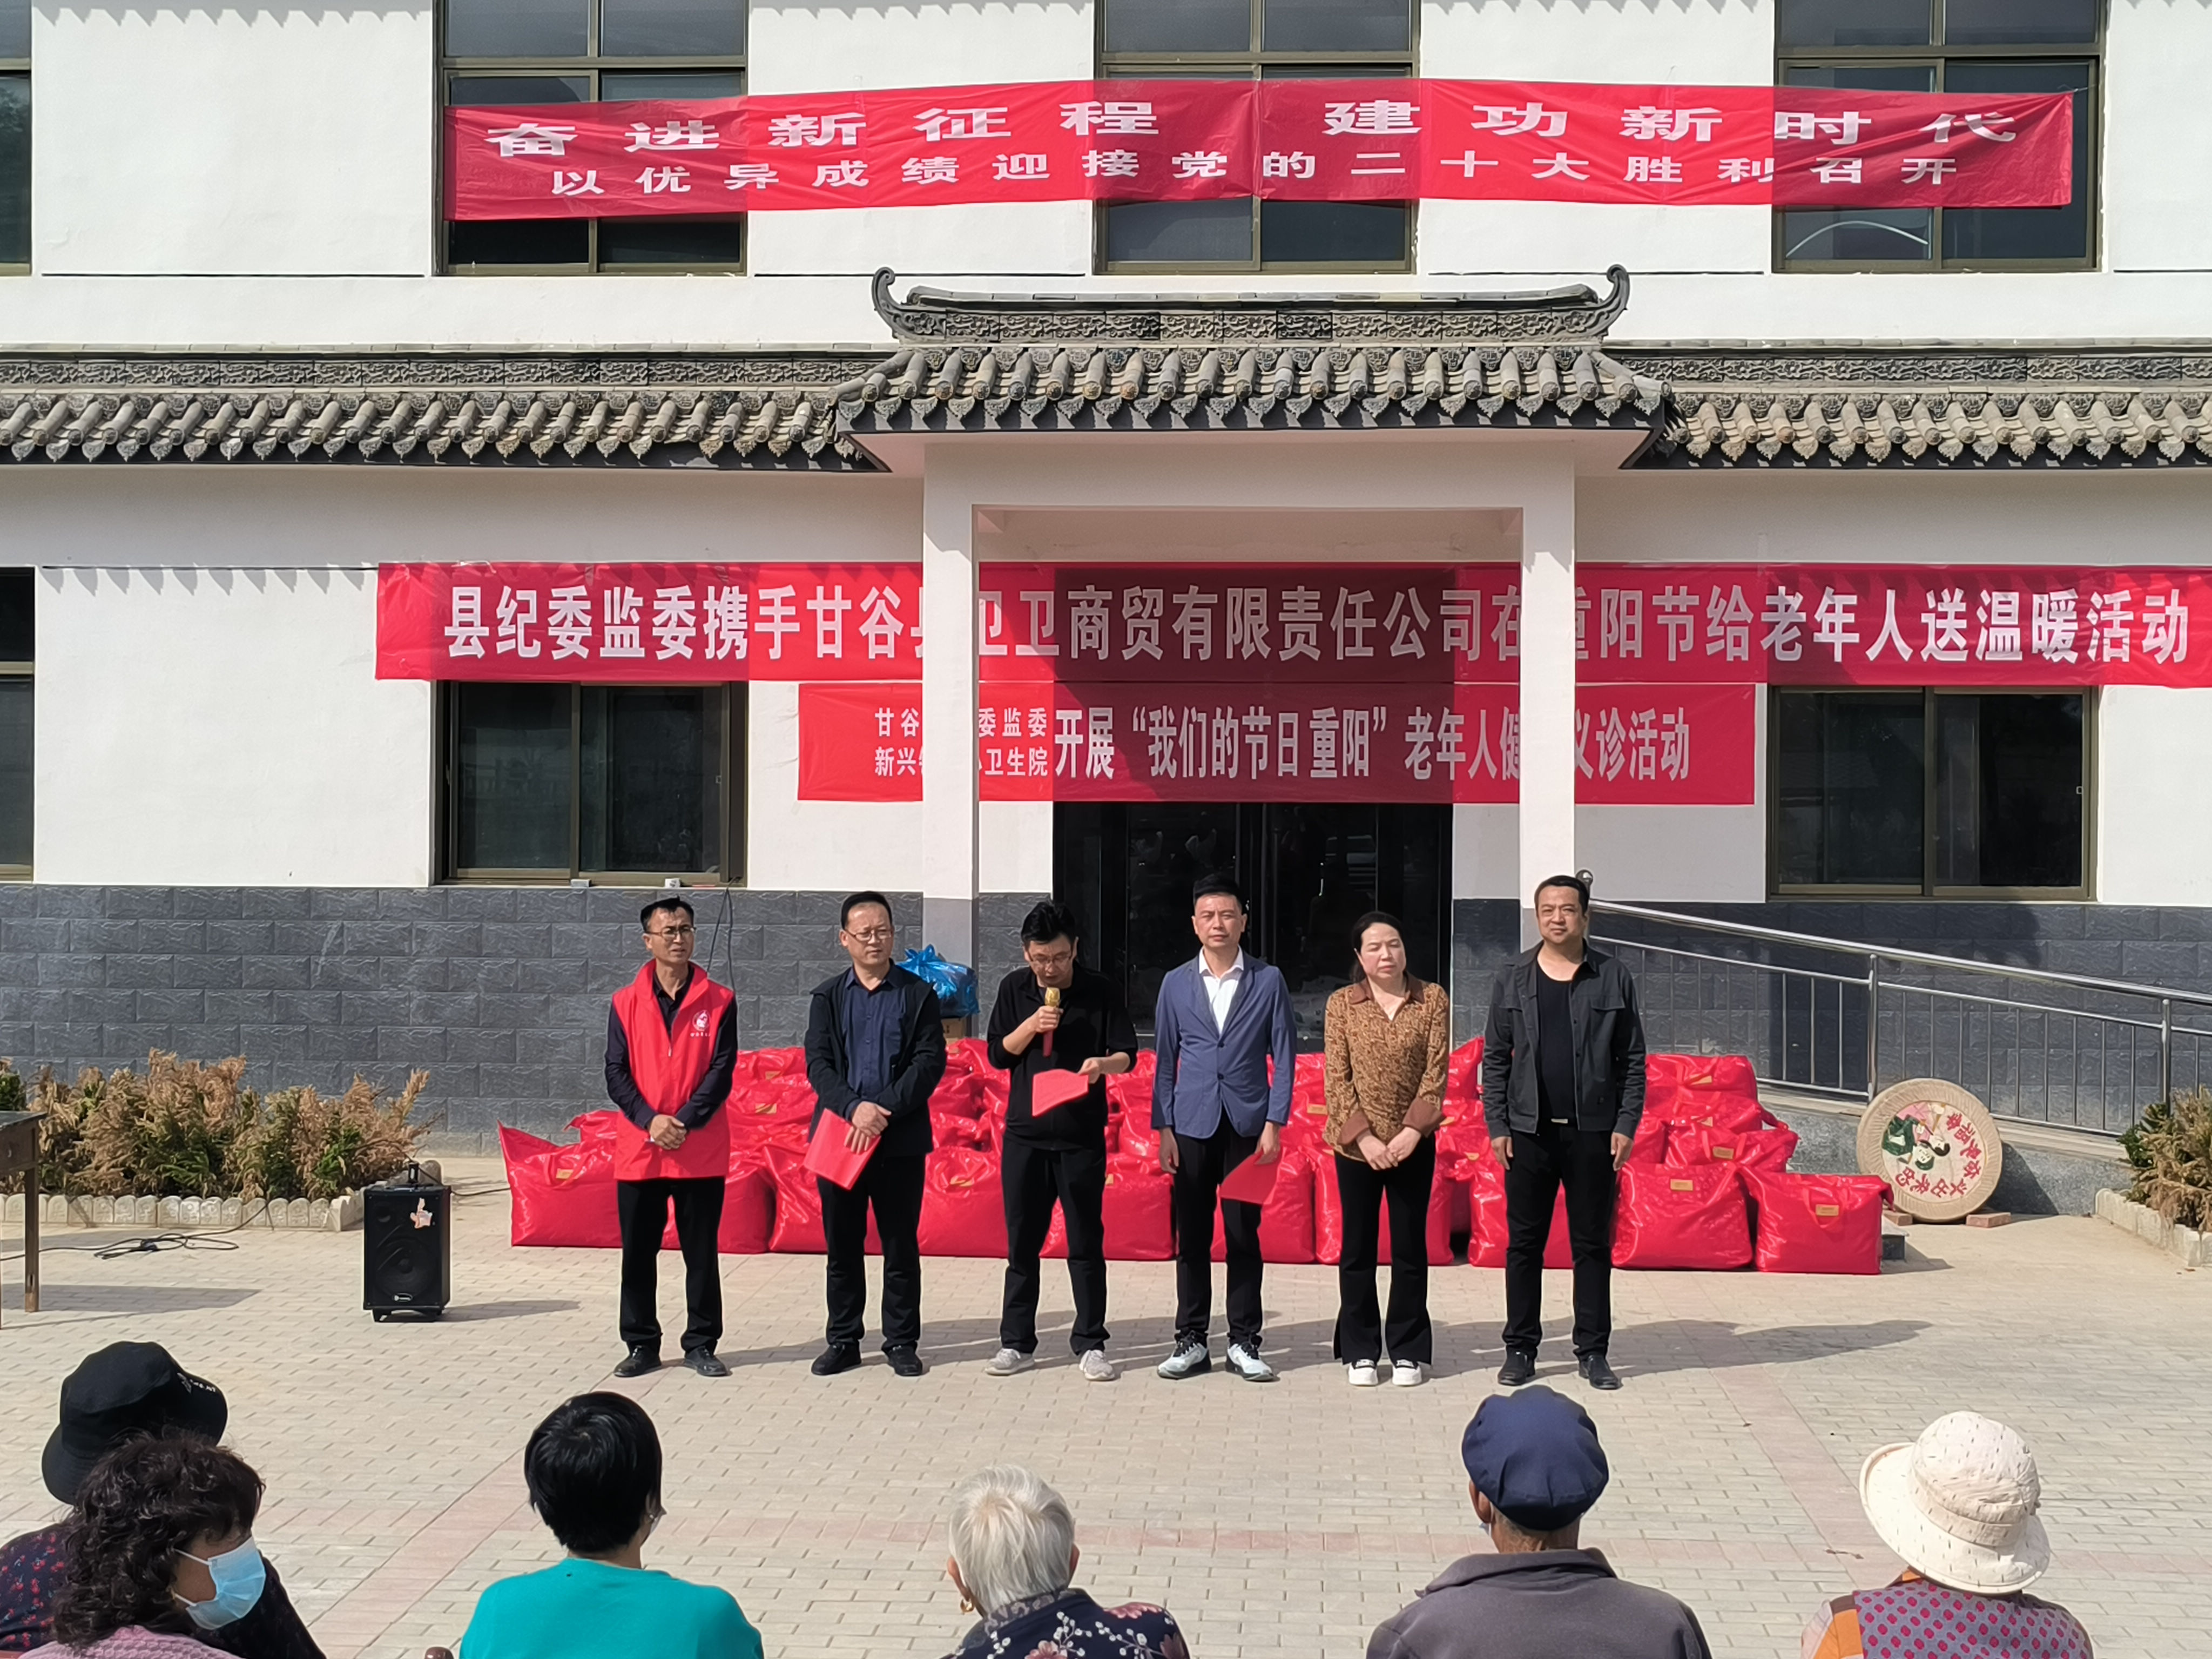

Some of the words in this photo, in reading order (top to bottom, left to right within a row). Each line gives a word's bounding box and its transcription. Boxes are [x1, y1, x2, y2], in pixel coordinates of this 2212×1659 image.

[485, 100, 1159, 157] 奋进新征程
[1323, 100, 2016, 144] 建功新时代
[552, 149, 1957, 196] 以优异成绩迎接党的二十大胜利召开
[444, 585, 2188, 664] 县纪委监委携手甘谷卫卫商贸有限责任公司在阳节给老年人送温暖活动
[875, 707, 1047, 737] 甘谷委监委
[875, 746, 1048, 777] 新兴卫生院
